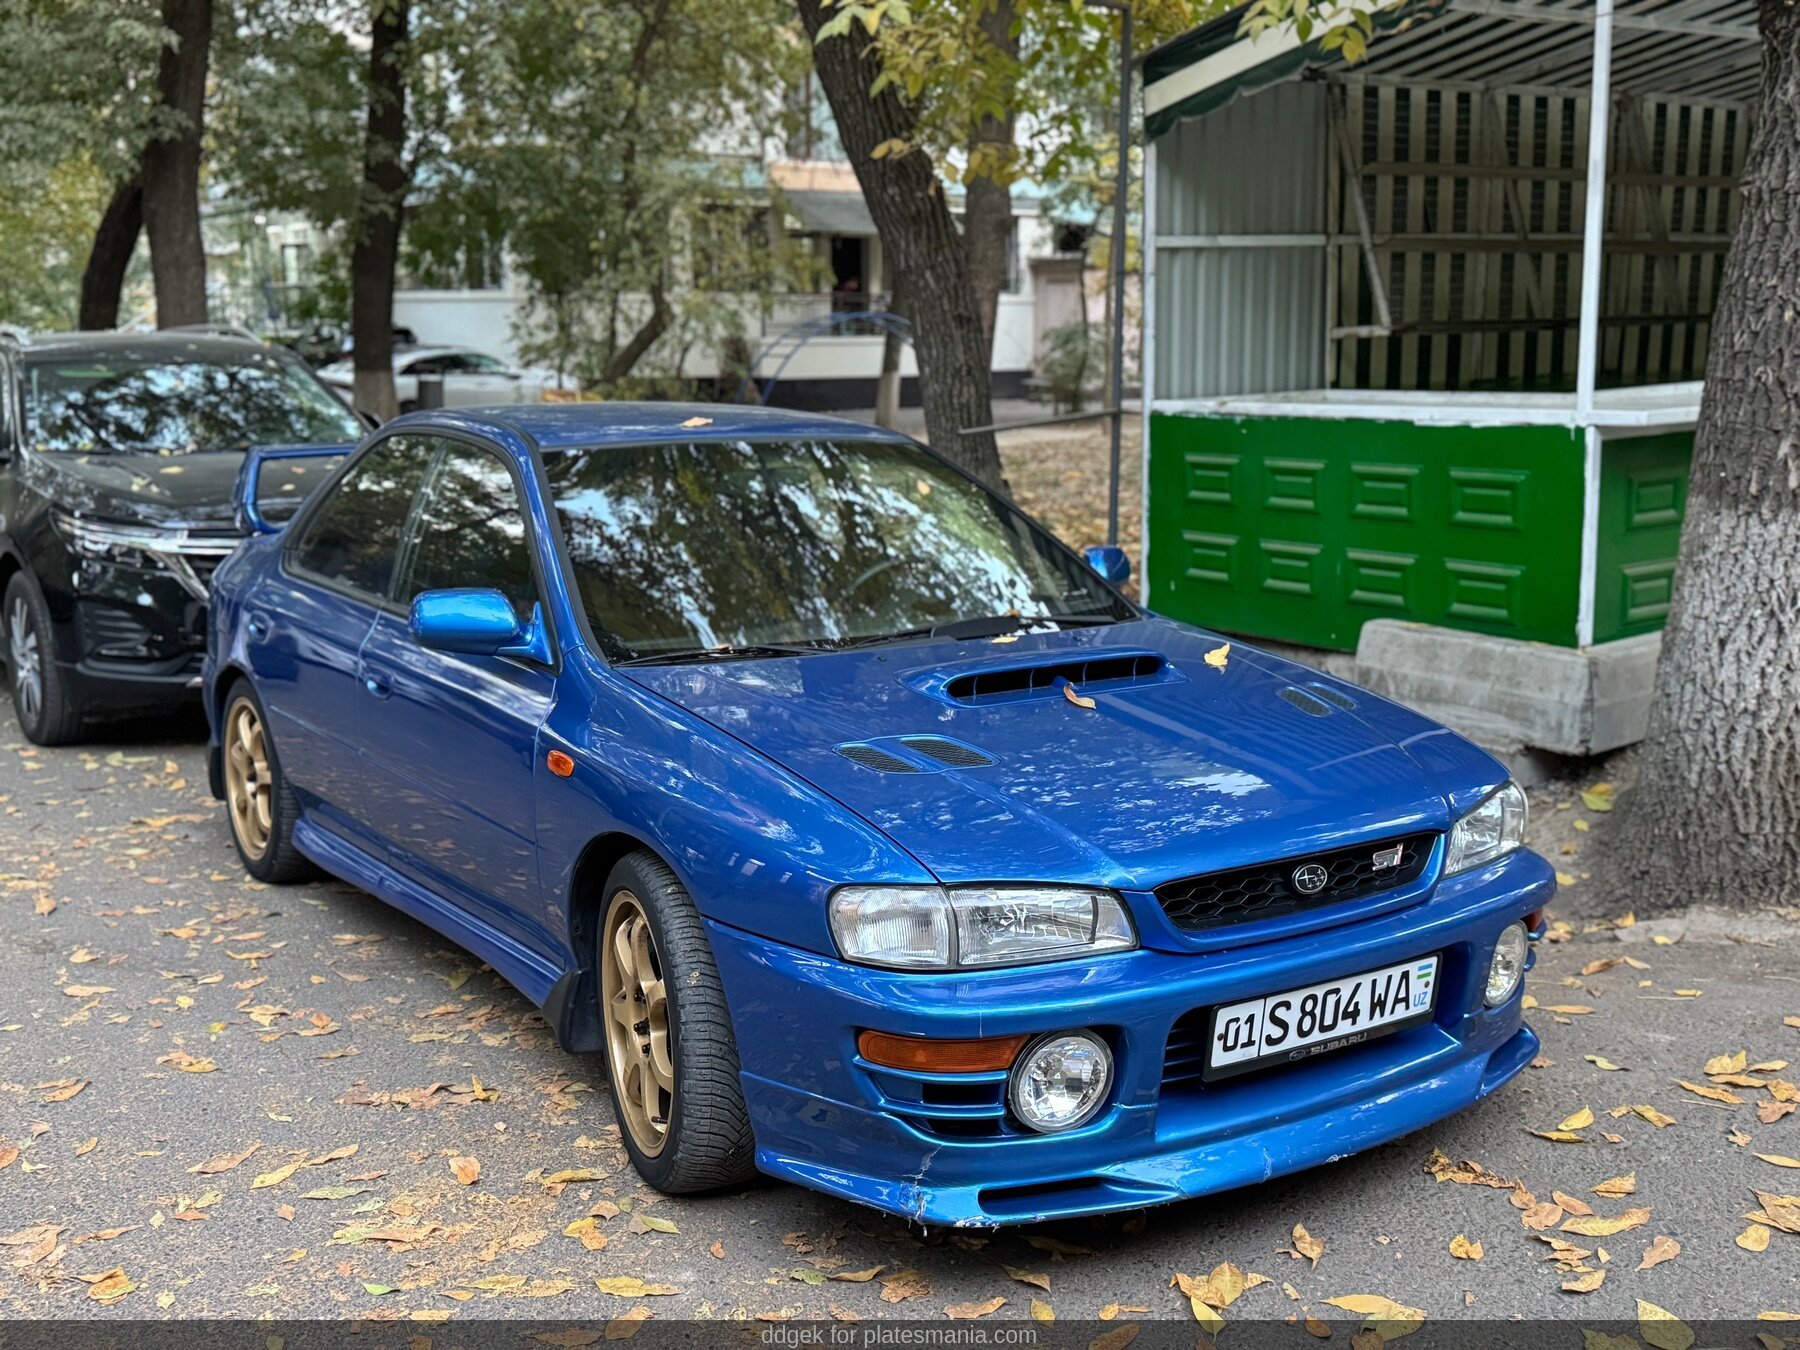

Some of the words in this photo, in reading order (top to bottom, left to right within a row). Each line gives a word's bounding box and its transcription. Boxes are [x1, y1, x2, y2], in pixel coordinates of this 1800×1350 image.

[1413, 991, 1428, 1008] UZ
[1222, 1013, 1256, 1052] 01
[1310, 1032, 1368, 1056] SUBARU
